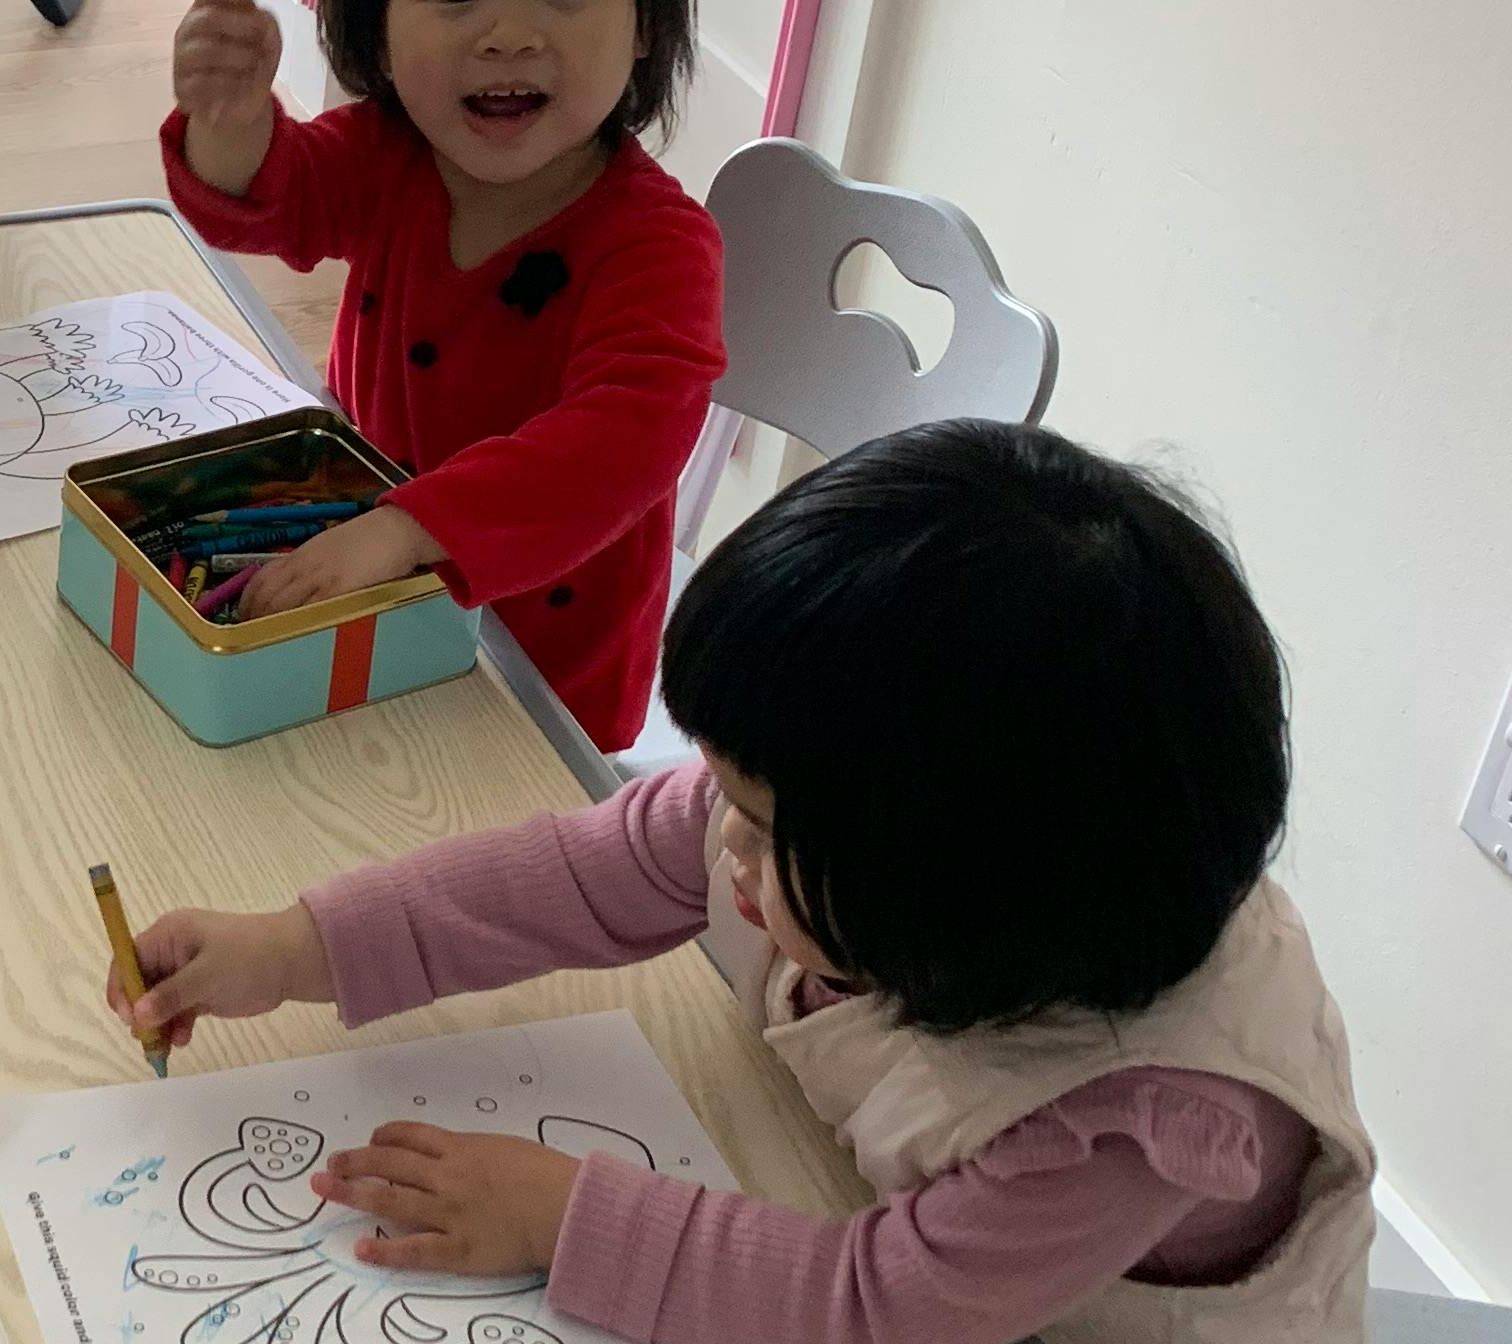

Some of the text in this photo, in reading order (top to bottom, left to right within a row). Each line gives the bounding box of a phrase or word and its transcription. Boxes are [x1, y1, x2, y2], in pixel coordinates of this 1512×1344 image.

[27, 1190, 44, 1219] Give
[38, 1220, 56, 1244] this
[46, 1245, 70, 1283] squid
[60, 1284, 81, 1318] color
[73, 1318, 93, 1344] and
